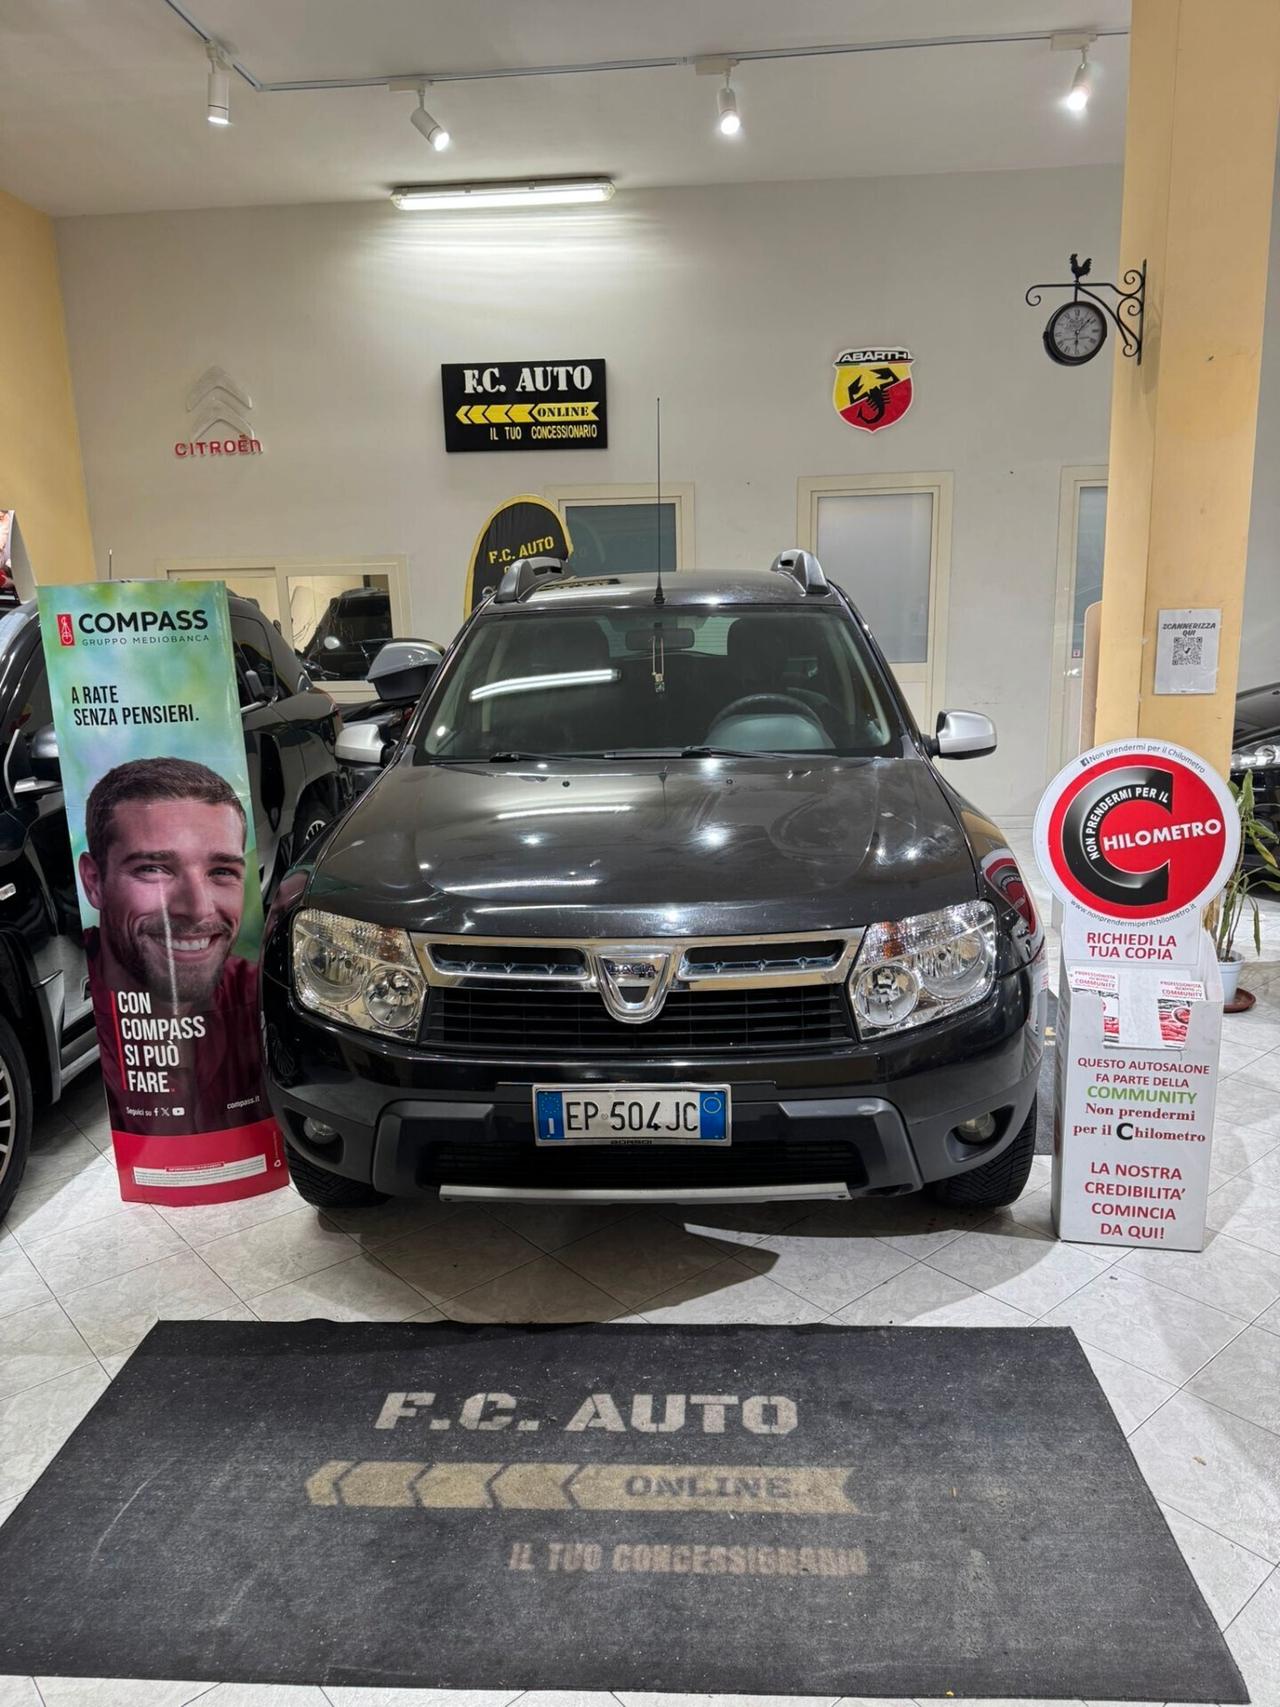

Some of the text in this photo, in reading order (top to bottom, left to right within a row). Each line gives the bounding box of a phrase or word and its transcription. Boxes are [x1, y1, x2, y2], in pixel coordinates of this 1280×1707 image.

[841, 351, 907, 362] ABARTH
[463, 365, 592, 394] F.C. AUTO
[538, 406, 590, 417] ONLINE
[489, 424, 598, 440] IL TUO CONCESSIONARIO
[488, 536, 554, 564] F.C. AUTO
[78, 609, 209, 634] COMPASS
[1162, 622, 1216, 630] SCANNERIZZA
[82, 634, 210, 647] GRUPPO MEDIOBANCA
[71, 685, 119, 704] A RATE
[74, 704, 199, 726] SENZA PENSIERI.
[1089, 744, 1206, 774] Non prendermi per il Chilometro
[1085, 787, 1169, 860] NON PRENDERMI PER IL
[1087, 932, 1177, 947] RICHIEDI LA
[1089, 945, 1173, 960] TUA COPIA
[117, 991, 152, 1014] CON
[121, 1015, 206, 1040] COMPASS
[124, 1040, 180, 1067] SI PUÒ
[1078, 1057, 1210, 1074] QUESTO AUTOSALONE
[1096, 1073, 1189, 1088] FA PARTE DELLA
[1087, 1085, 1197, 1104] COMMUNITY
[565, 1101, 599, 1131] EP
[1085, 1102, 1196, 1121] Non prendermi
[1073, 1122, 1206, 1142] per il Chilometro
[1091, 1161, 1182, 1180] LA NOSTRA
[1091, 1202, 1176, 1220] COMINCIA
[1100, 1223, 1165, 1239] DA QUI!
[375, 1391, 799, 1435] F.C. AUTO
[624, 1474, 793, 1500] ONLINE
[509, 1542, 535, 1572] IL
[548, 1543, 602, 1573] TUO
